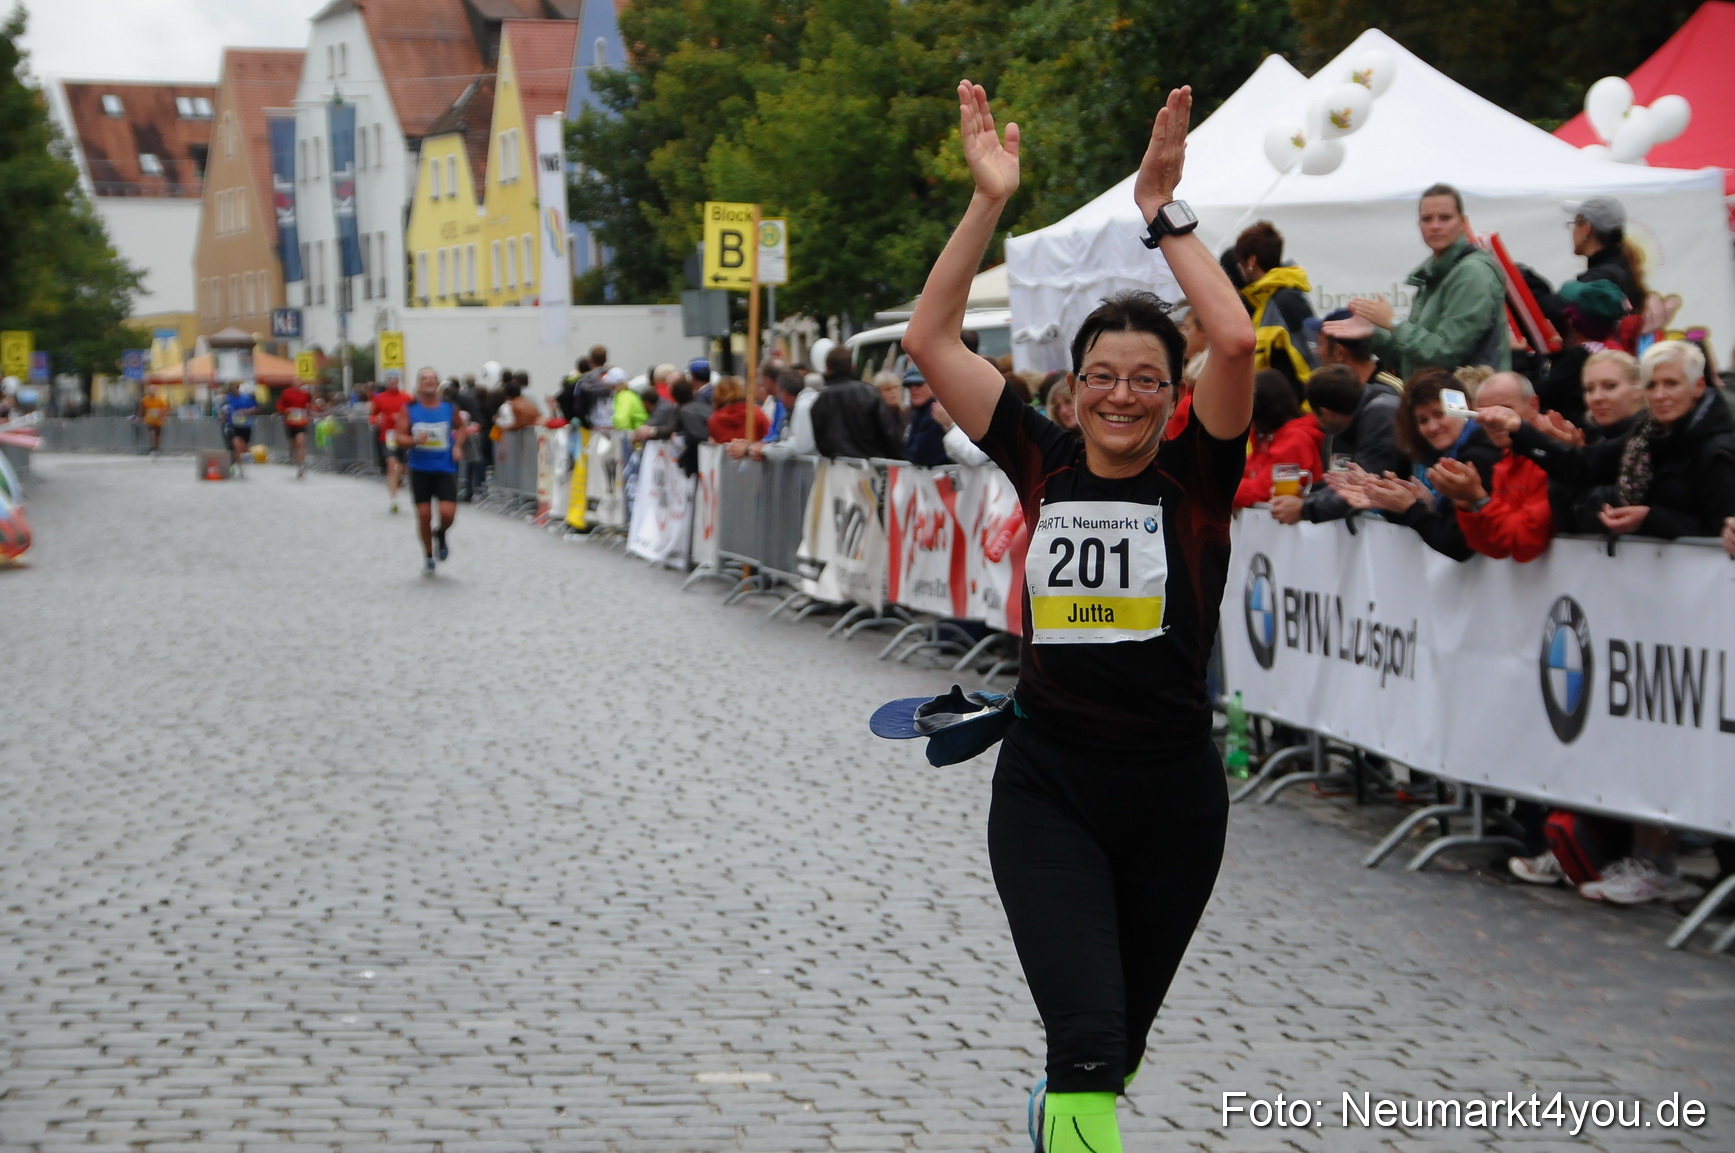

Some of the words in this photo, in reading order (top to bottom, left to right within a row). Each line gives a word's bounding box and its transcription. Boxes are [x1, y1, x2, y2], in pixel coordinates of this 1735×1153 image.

[712, 206, 753, 221] Block
[720, 229, 744, 268] B
[1037, 516, 1069, 532] PARTL
[1072, 516, 1139, 530] Neumarkt
[1047, 537, 1130, 589] 201
[1067, 603, 1115, 623] Jutta
[1608, 638, 1709, 729] BMW
